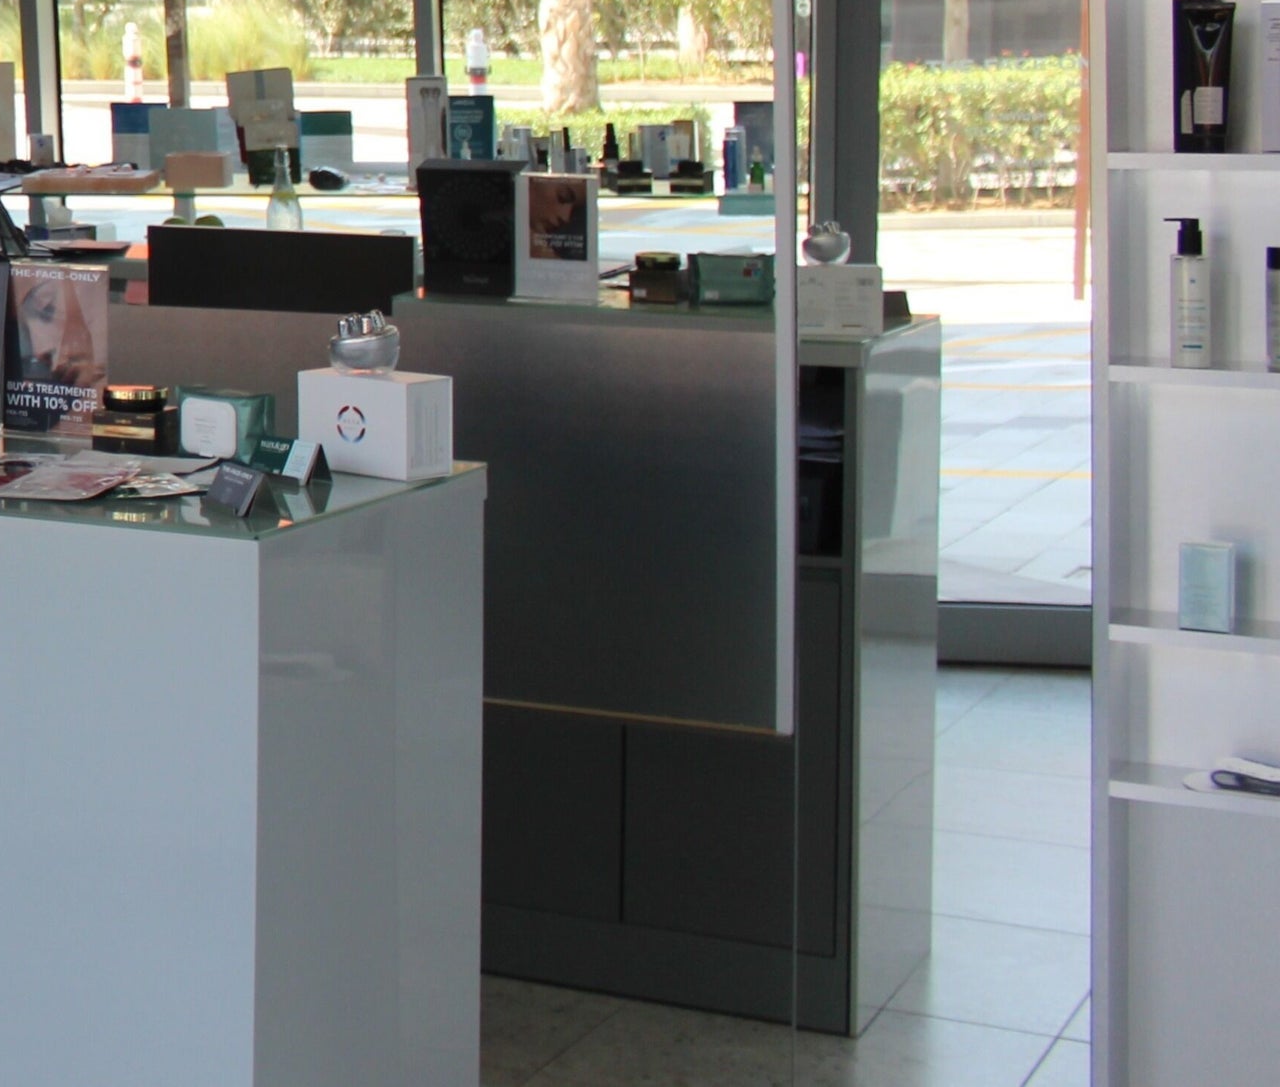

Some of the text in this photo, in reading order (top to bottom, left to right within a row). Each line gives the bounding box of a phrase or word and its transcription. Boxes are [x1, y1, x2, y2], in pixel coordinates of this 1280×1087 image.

[6, 381, 97, 399] BUY 5 TREATMENTS
[7, 394, 98, 413] WITH 10% OFF
